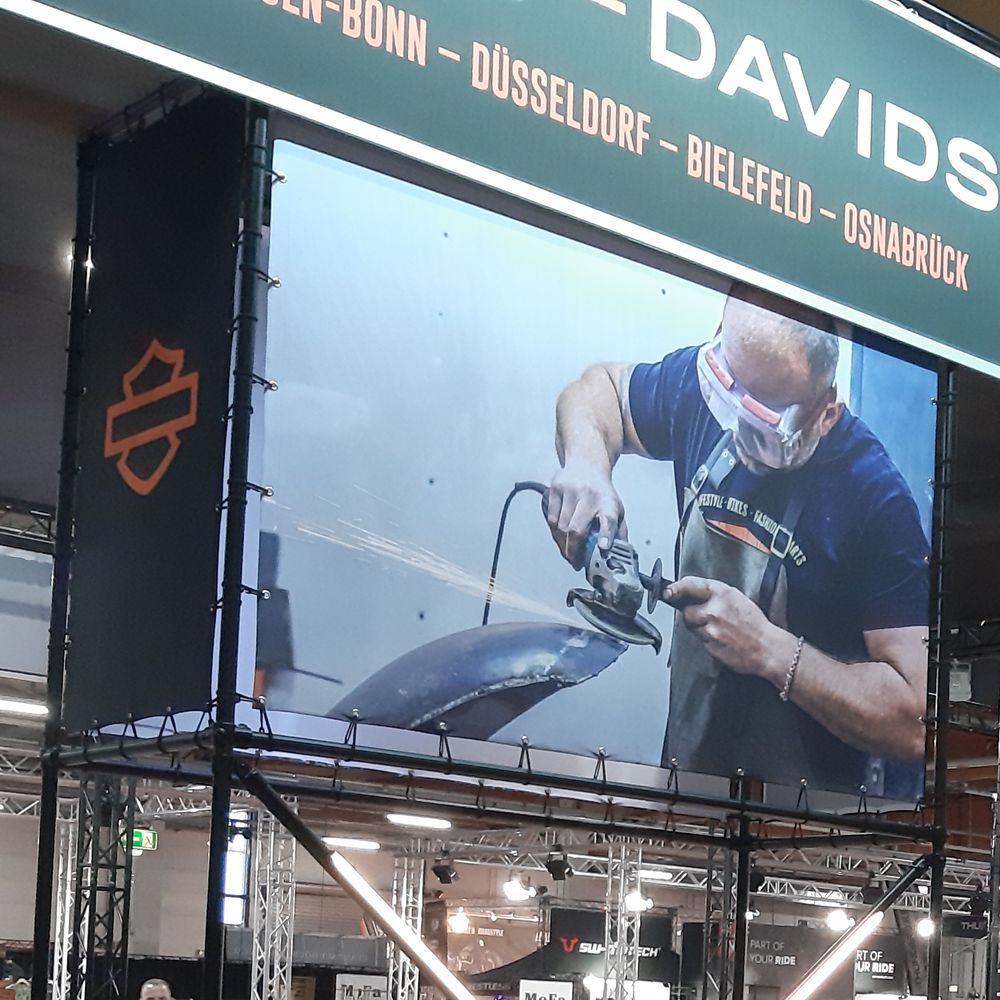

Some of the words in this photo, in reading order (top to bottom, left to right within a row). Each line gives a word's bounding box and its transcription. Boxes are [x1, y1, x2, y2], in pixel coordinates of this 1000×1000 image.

[471, 41, 652, 156] DÜSSELDORF
[686, 132, 812, 224] BIELEFELD
[842, 202, 970, 292] OSNABRÜCK
[753, 510, 778, 534] FASHIO
[750, 940, 771, 950] PART
[773, 941, 785, 951] OF
[749, 953, 774, 964] YOUR
[775, 956, 796, 966] RIDE
[870, 951, 884, 961] OF
[872, 961, 895, 974] RIDE
